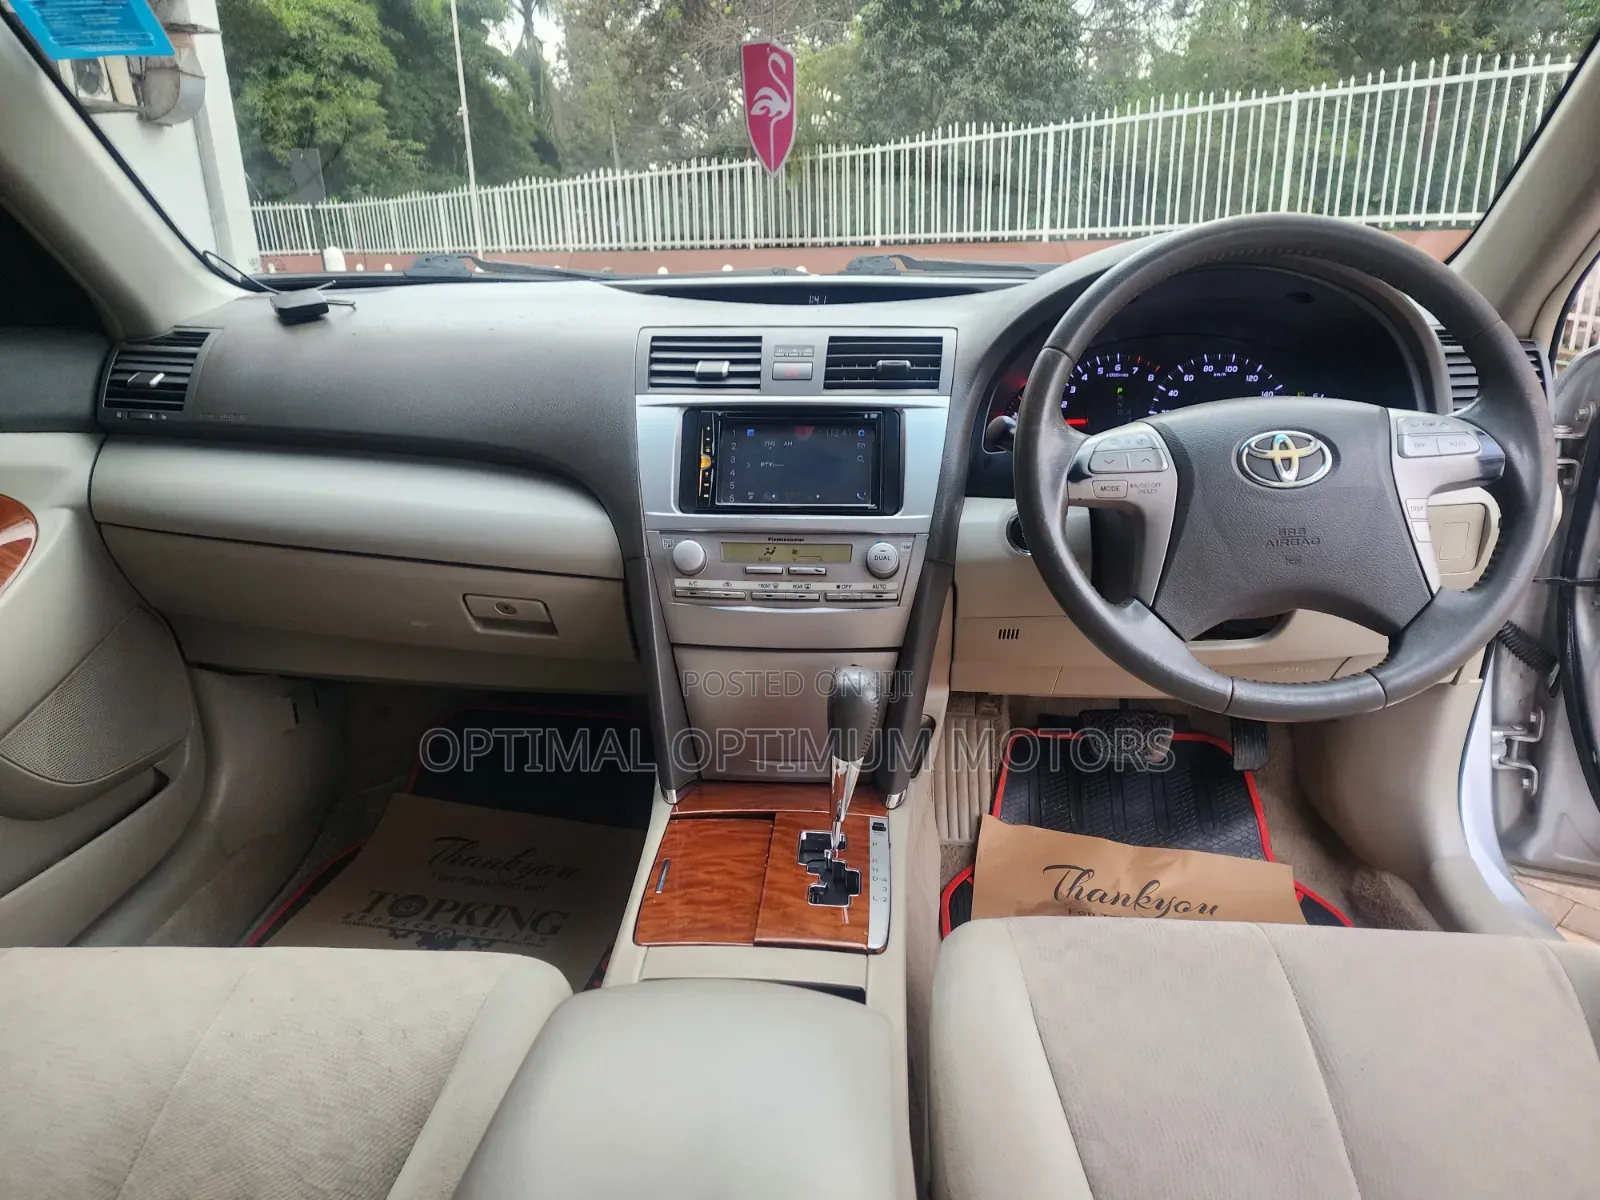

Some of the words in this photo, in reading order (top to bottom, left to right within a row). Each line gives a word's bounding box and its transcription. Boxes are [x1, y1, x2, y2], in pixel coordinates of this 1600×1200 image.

[1097, 367, 1104, 375] 5
[1114, 363, 1121, 371] 6
[1132, 366, 1139, 374] 7
[1203, 365, 1214, 373] 80
[1225, 365, 1238, 373] 100
[1081, 373, 1088, 381] 4
[1147, 373, 1155, 381] 8
[1183, 374, 1194, 382] 60
[1246, 374, 1259, 382] 120
[1069, 385, 1077, 394] 3
[1168, 389, 1179, 397] 40
[1061, 400, 1068, 408] 2
[731, 442, 737, 450] 2
[730, 455, 736, 463] 3
[729, 469, 736, 477] 4
[729, 481, 736, 489] 5
[1410, 504, 1424, 512] DISP
[1265, 537, 1321, 548] AIRBAG
[1042, 864, 1219, 918] Thankyou
[361, 889, 571, 937] TOPKING
[342, 911, 439, 931] SERVICE
